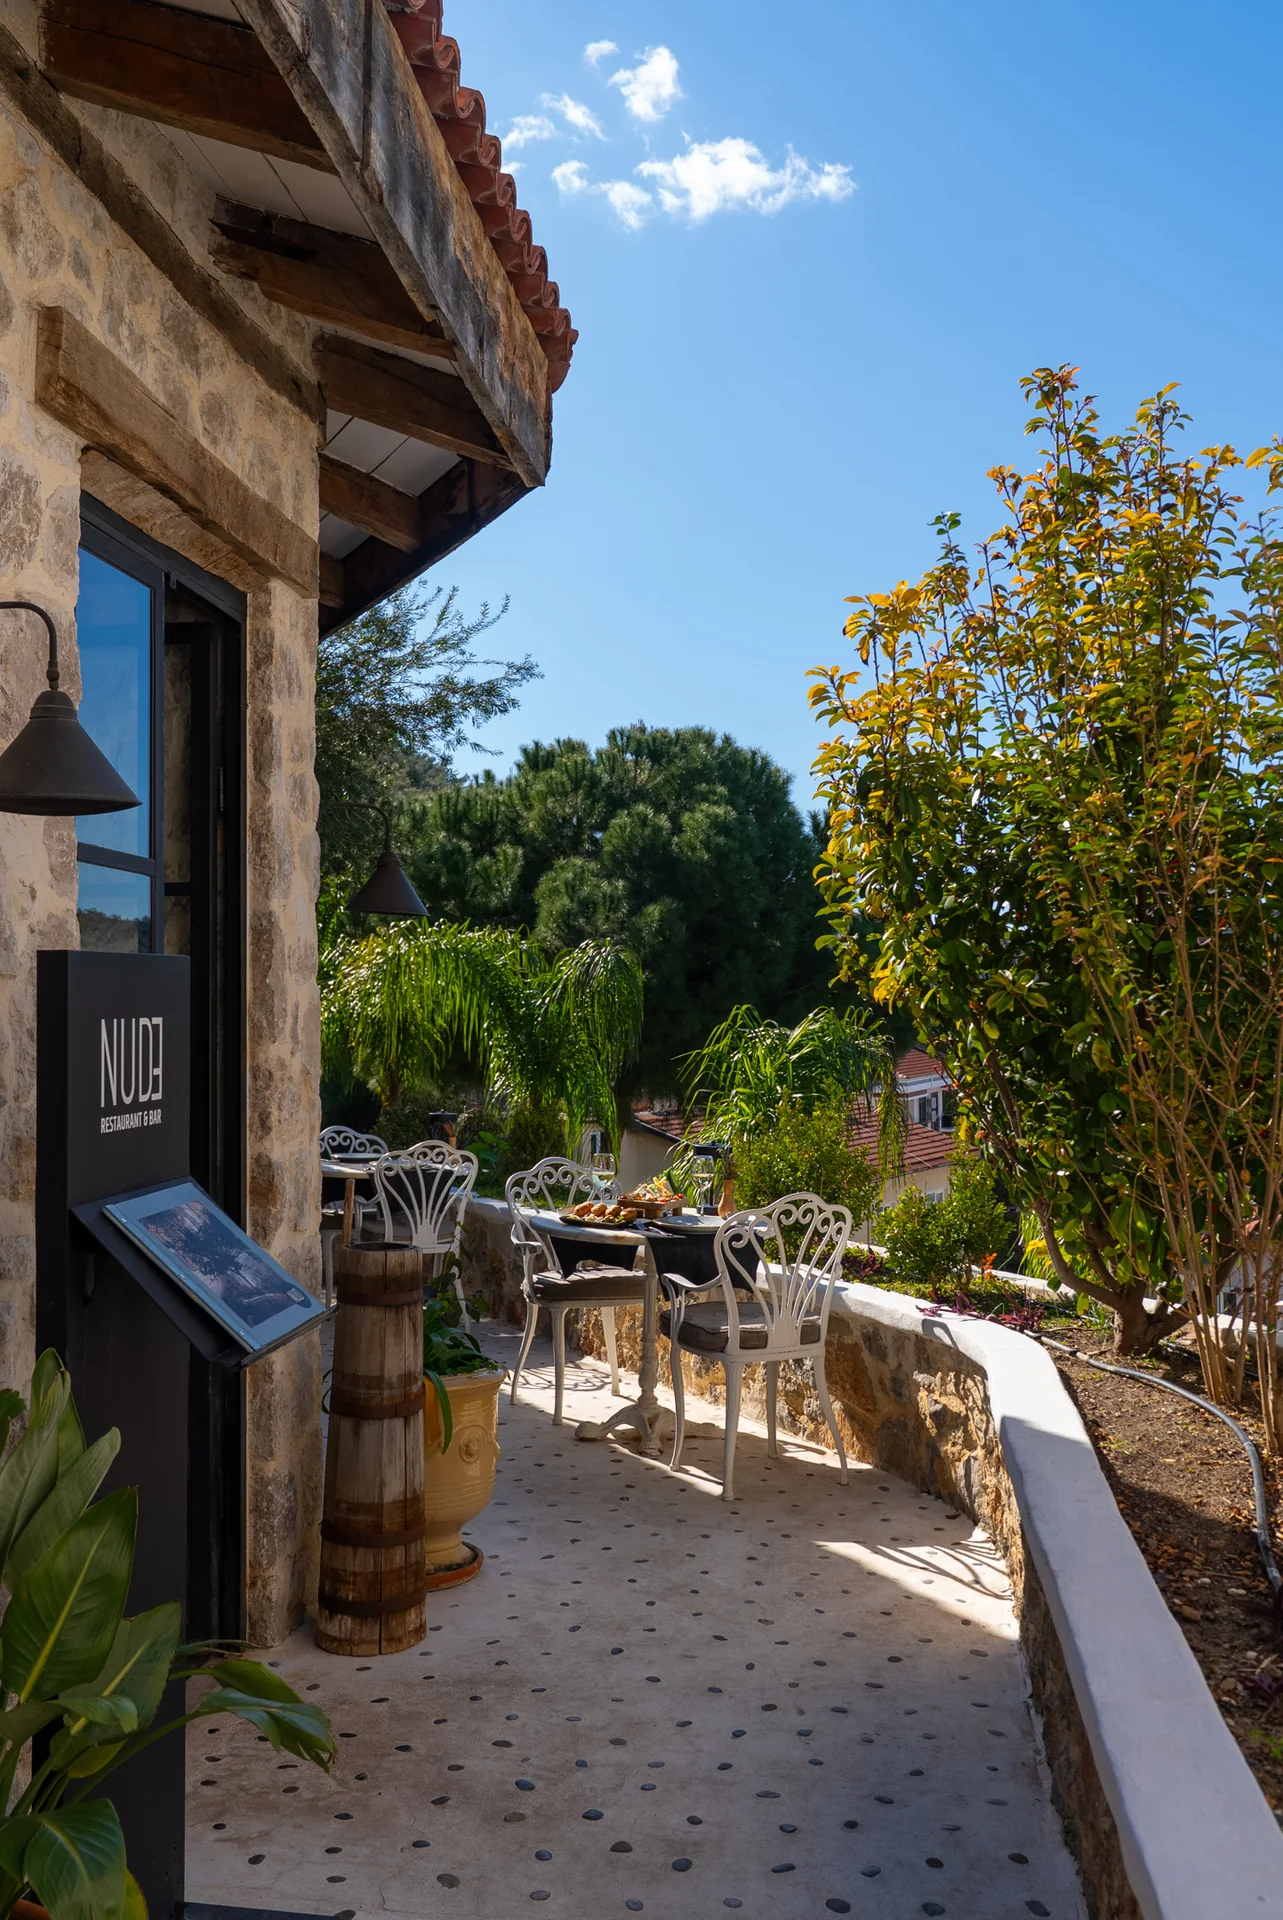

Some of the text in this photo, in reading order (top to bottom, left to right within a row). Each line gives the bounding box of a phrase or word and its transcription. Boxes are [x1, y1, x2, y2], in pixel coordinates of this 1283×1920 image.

[101, 1109, 161, 1133] RESTAURANT & BAR
